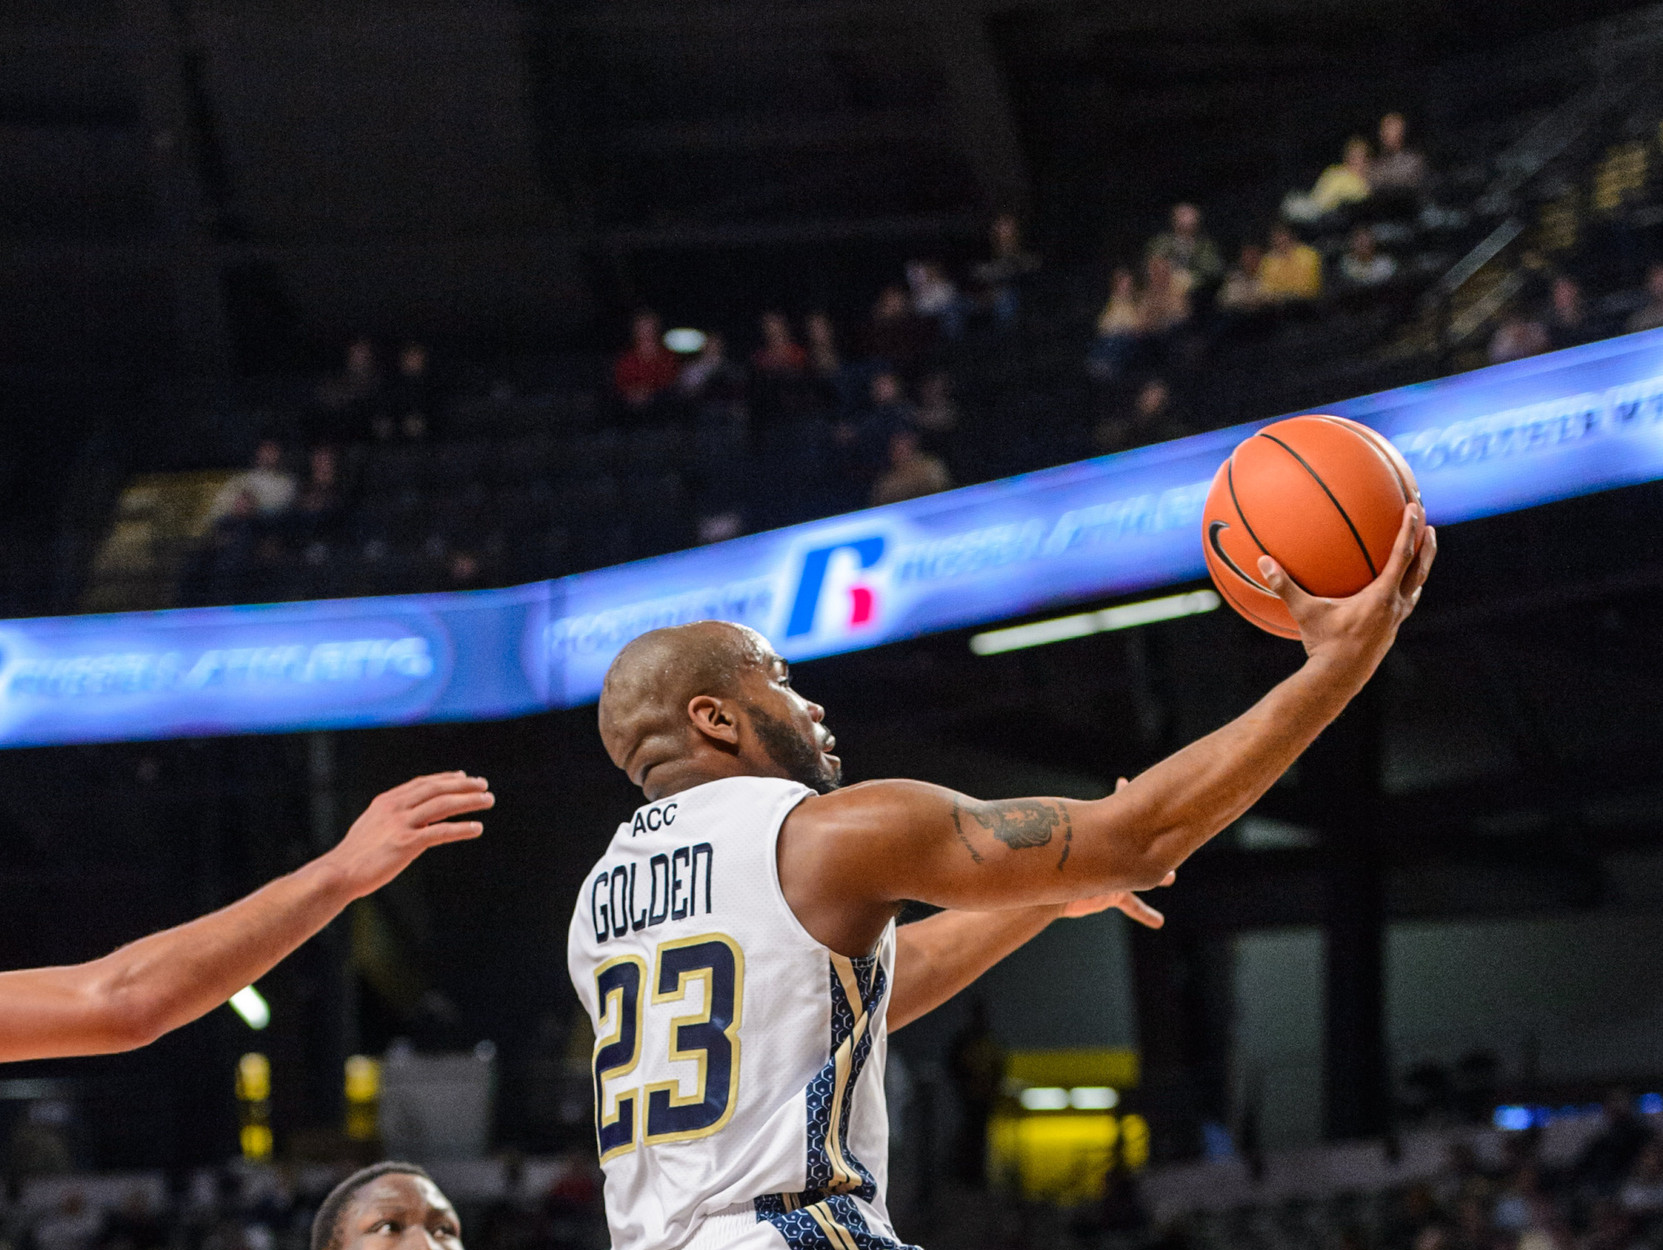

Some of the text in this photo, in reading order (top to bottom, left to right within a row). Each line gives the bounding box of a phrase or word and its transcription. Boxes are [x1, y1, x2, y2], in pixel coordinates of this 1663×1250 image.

[631, 802, 679, 838] ACC
[592, 842, 713, 944] GOLDEN
[593, 931, 745, 1168] 23
